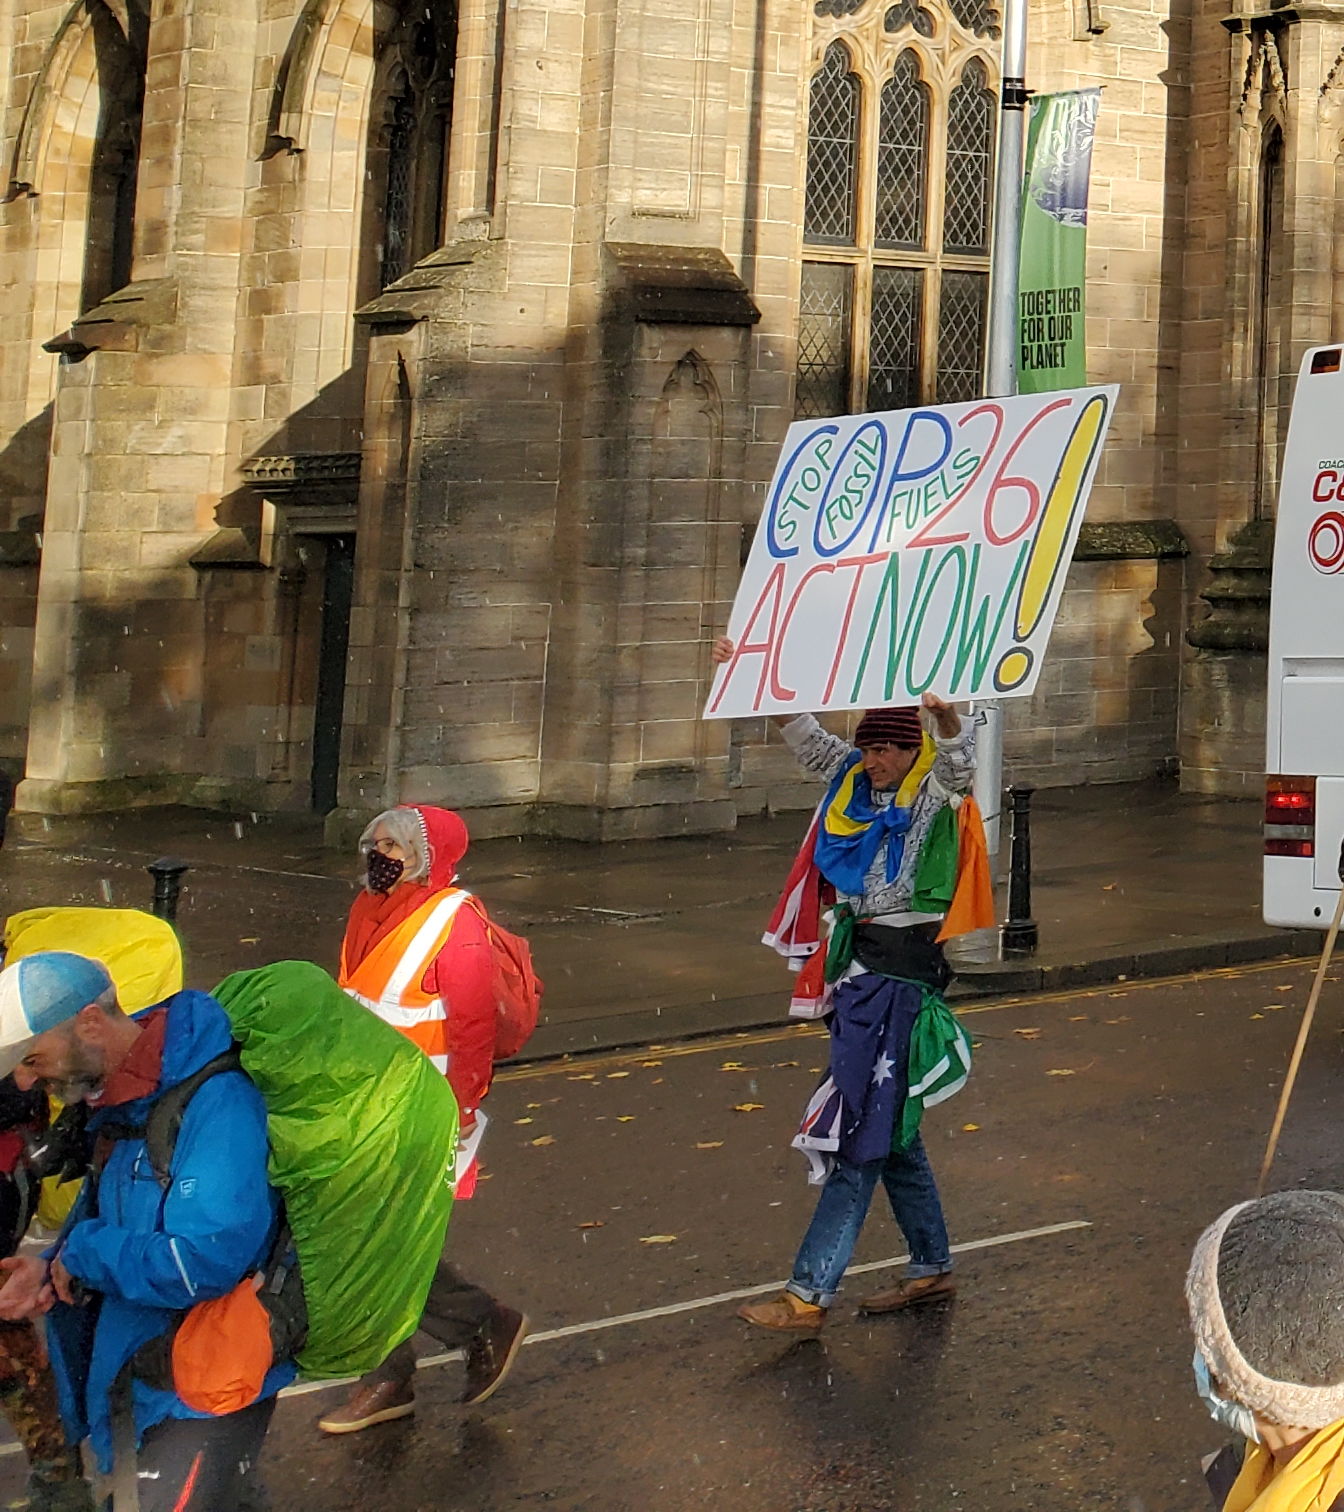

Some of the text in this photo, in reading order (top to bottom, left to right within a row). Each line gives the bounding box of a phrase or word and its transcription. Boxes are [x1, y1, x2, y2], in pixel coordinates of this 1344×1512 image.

[1021, 287, 1081, 317] TOGETHER
[1021, 315, 1073, 344] FOR OUR
[1021, 342, 1066, 370] PLANET
[766, 397, 1073, 559] COP26
[777, 439, 834, 542] STOP
[887, 447, 982, 543] FUELS
[710, 551, 891, 714] ACT
